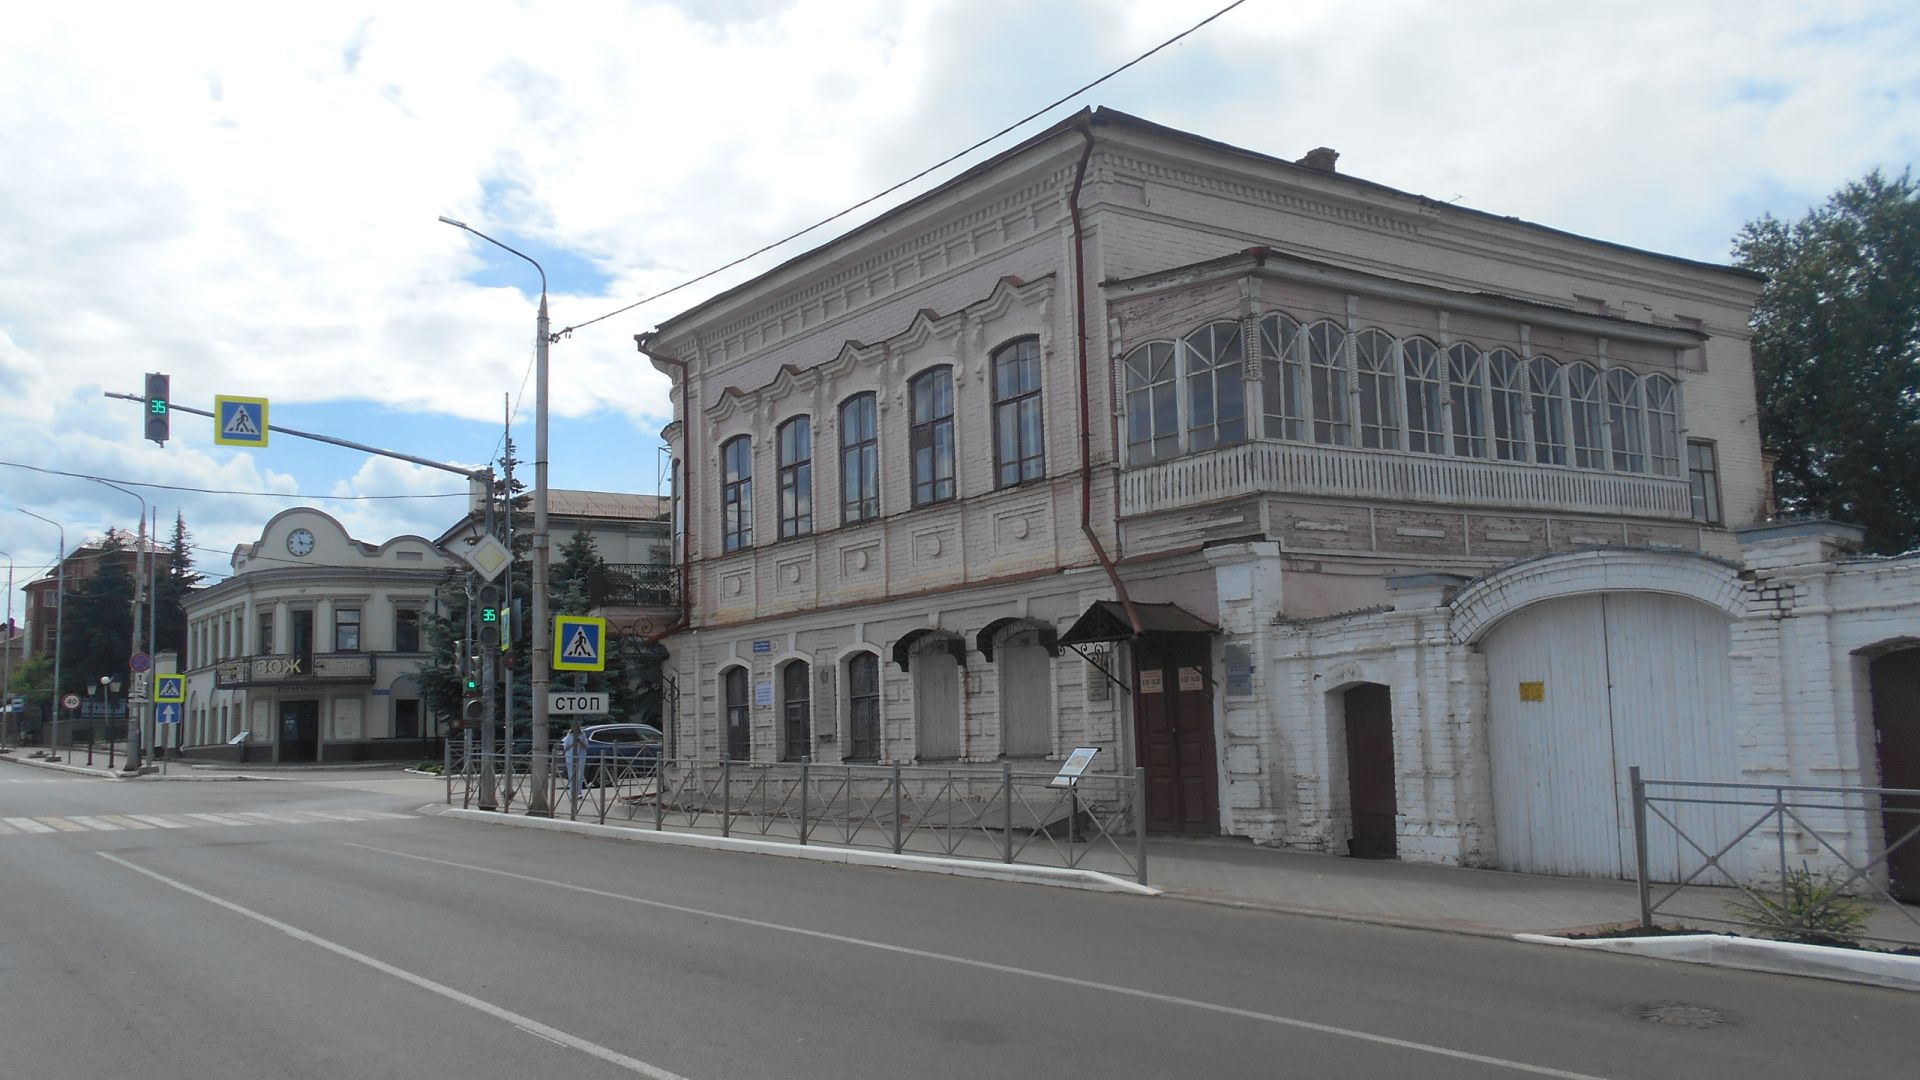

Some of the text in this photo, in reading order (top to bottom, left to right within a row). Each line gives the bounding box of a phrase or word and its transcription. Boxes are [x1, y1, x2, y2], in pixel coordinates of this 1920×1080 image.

[152, 400, 165, 413] 35
[483, 609, 496, 621] 35
[555, 697, 600, 710] СТОП
